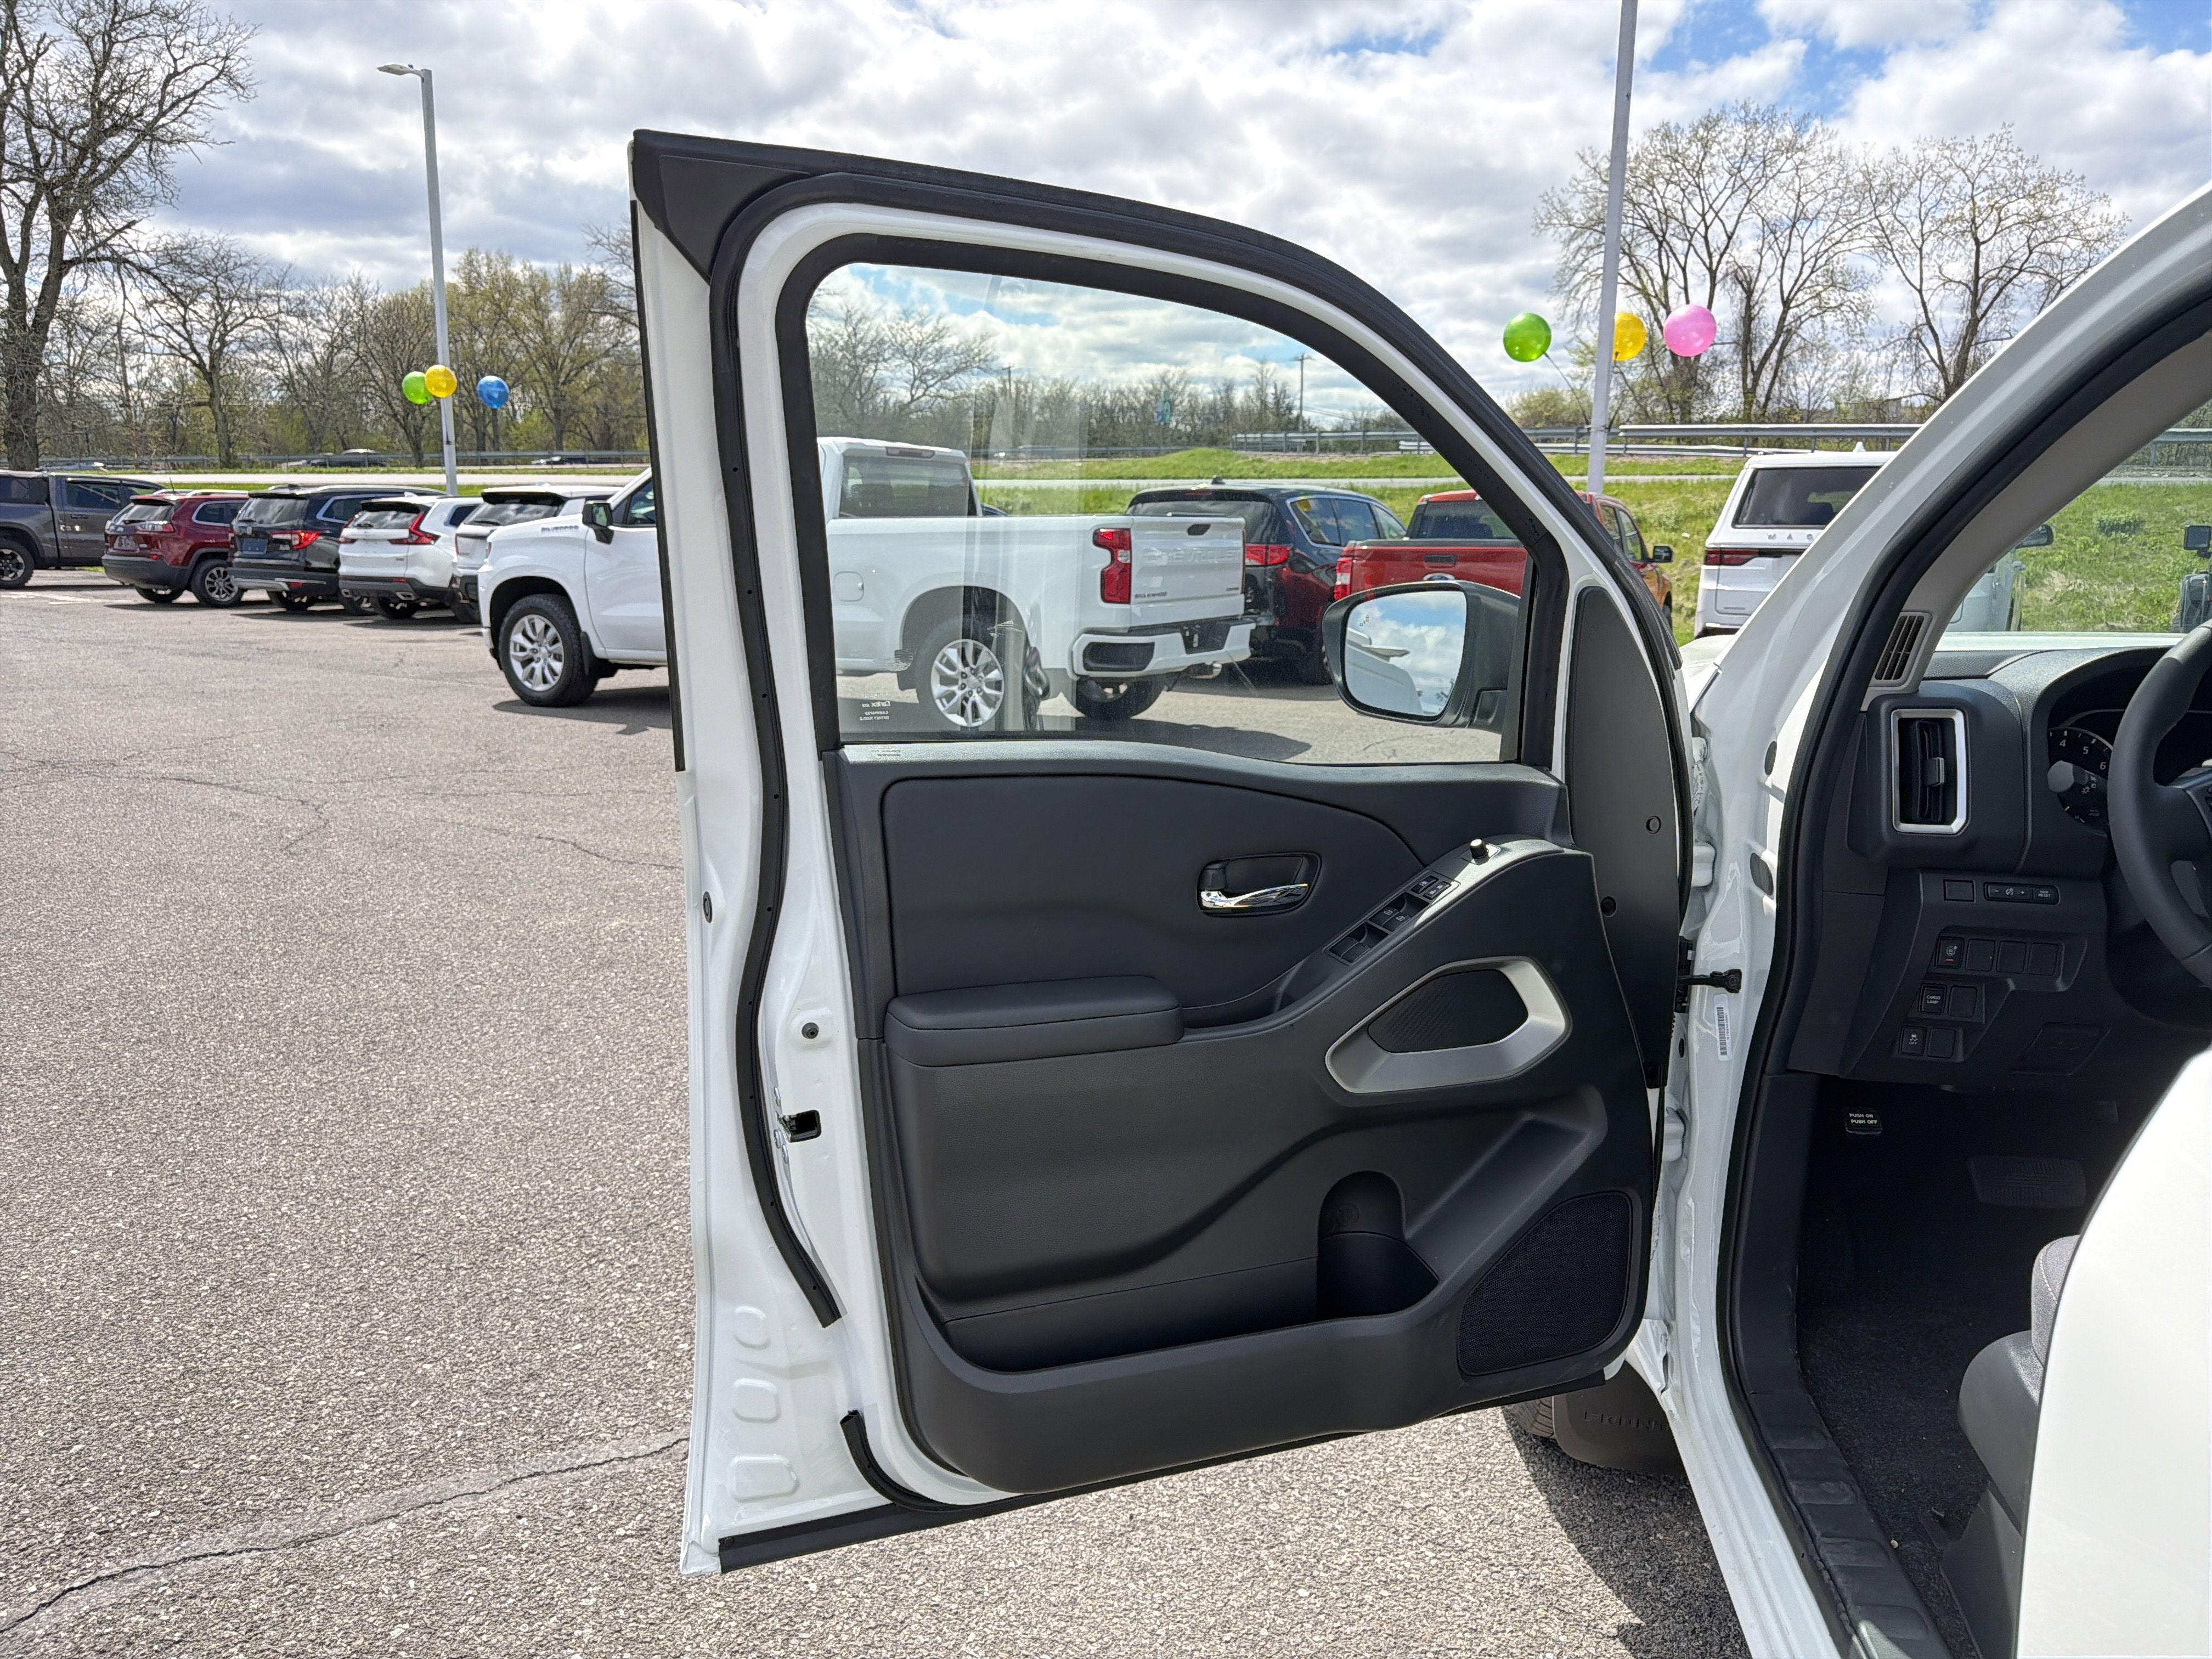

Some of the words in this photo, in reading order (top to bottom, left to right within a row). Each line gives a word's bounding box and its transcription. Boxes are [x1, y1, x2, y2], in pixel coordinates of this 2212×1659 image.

[2059, 739, 2067, 747] 4
[2083, 746, 2089, 754] 5
[2100, 761, 2106, 770] 6
